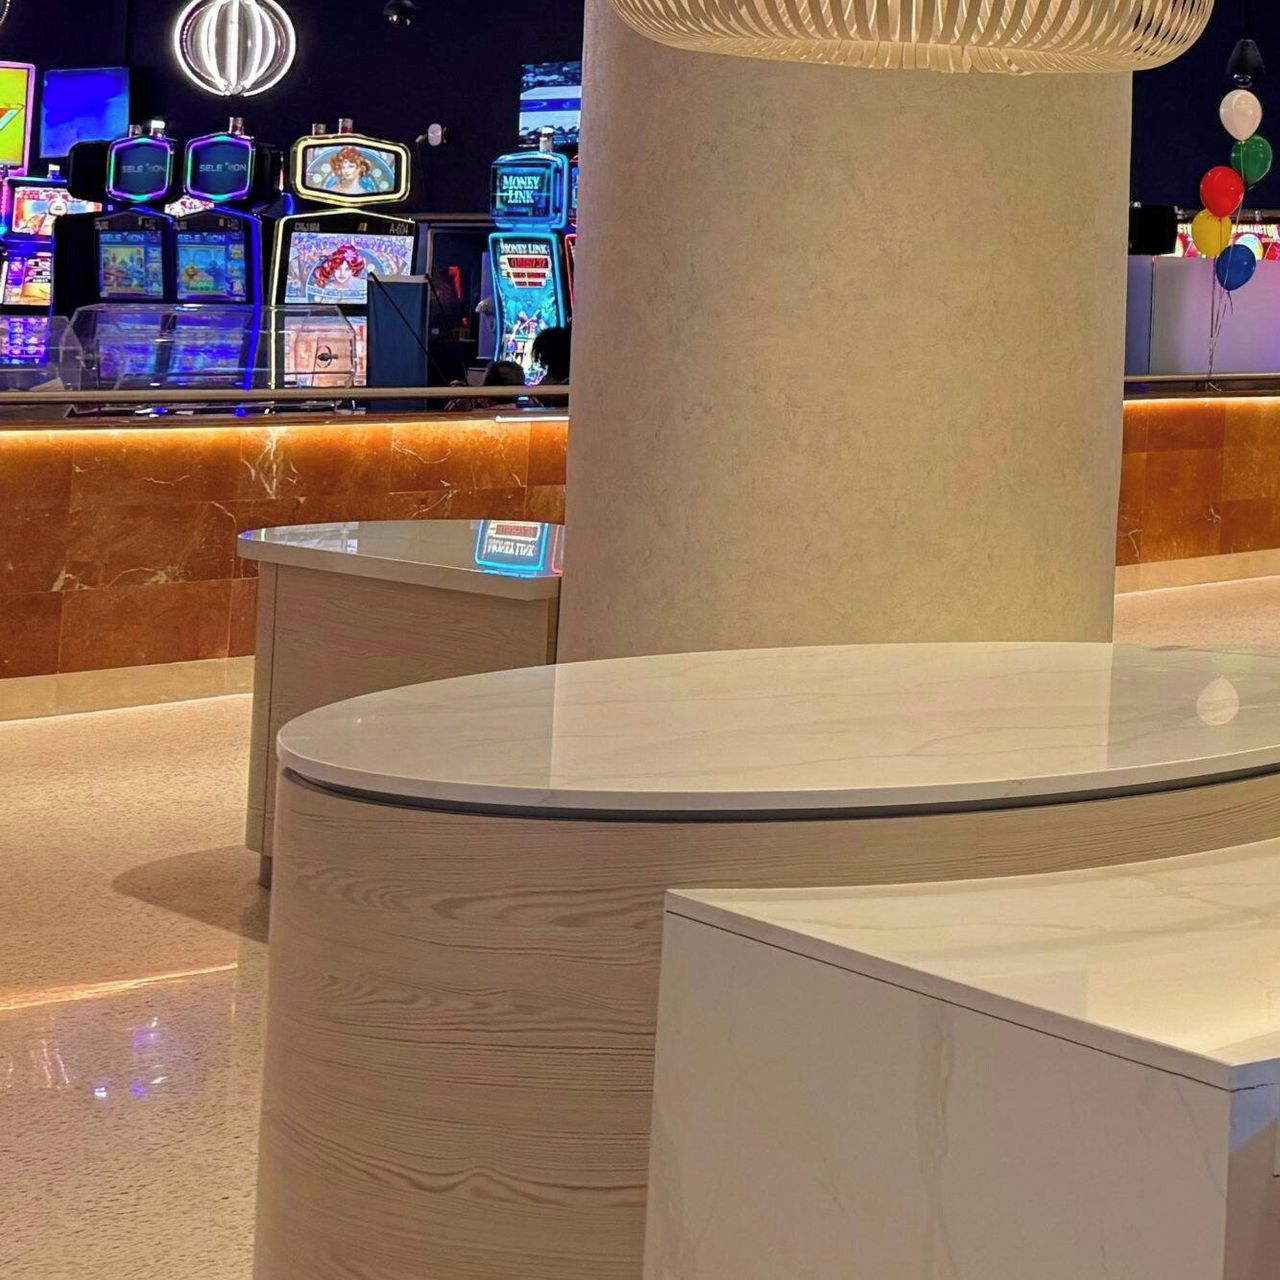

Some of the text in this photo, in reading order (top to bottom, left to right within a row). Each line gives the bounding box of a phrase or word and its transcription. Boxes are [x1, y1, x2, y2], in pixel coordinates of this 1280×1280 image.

[502, 175, 540, 189] MONEY
[507, 190, 535, 203] LINK
[500, 243, 548, 254] MONEY LINK
